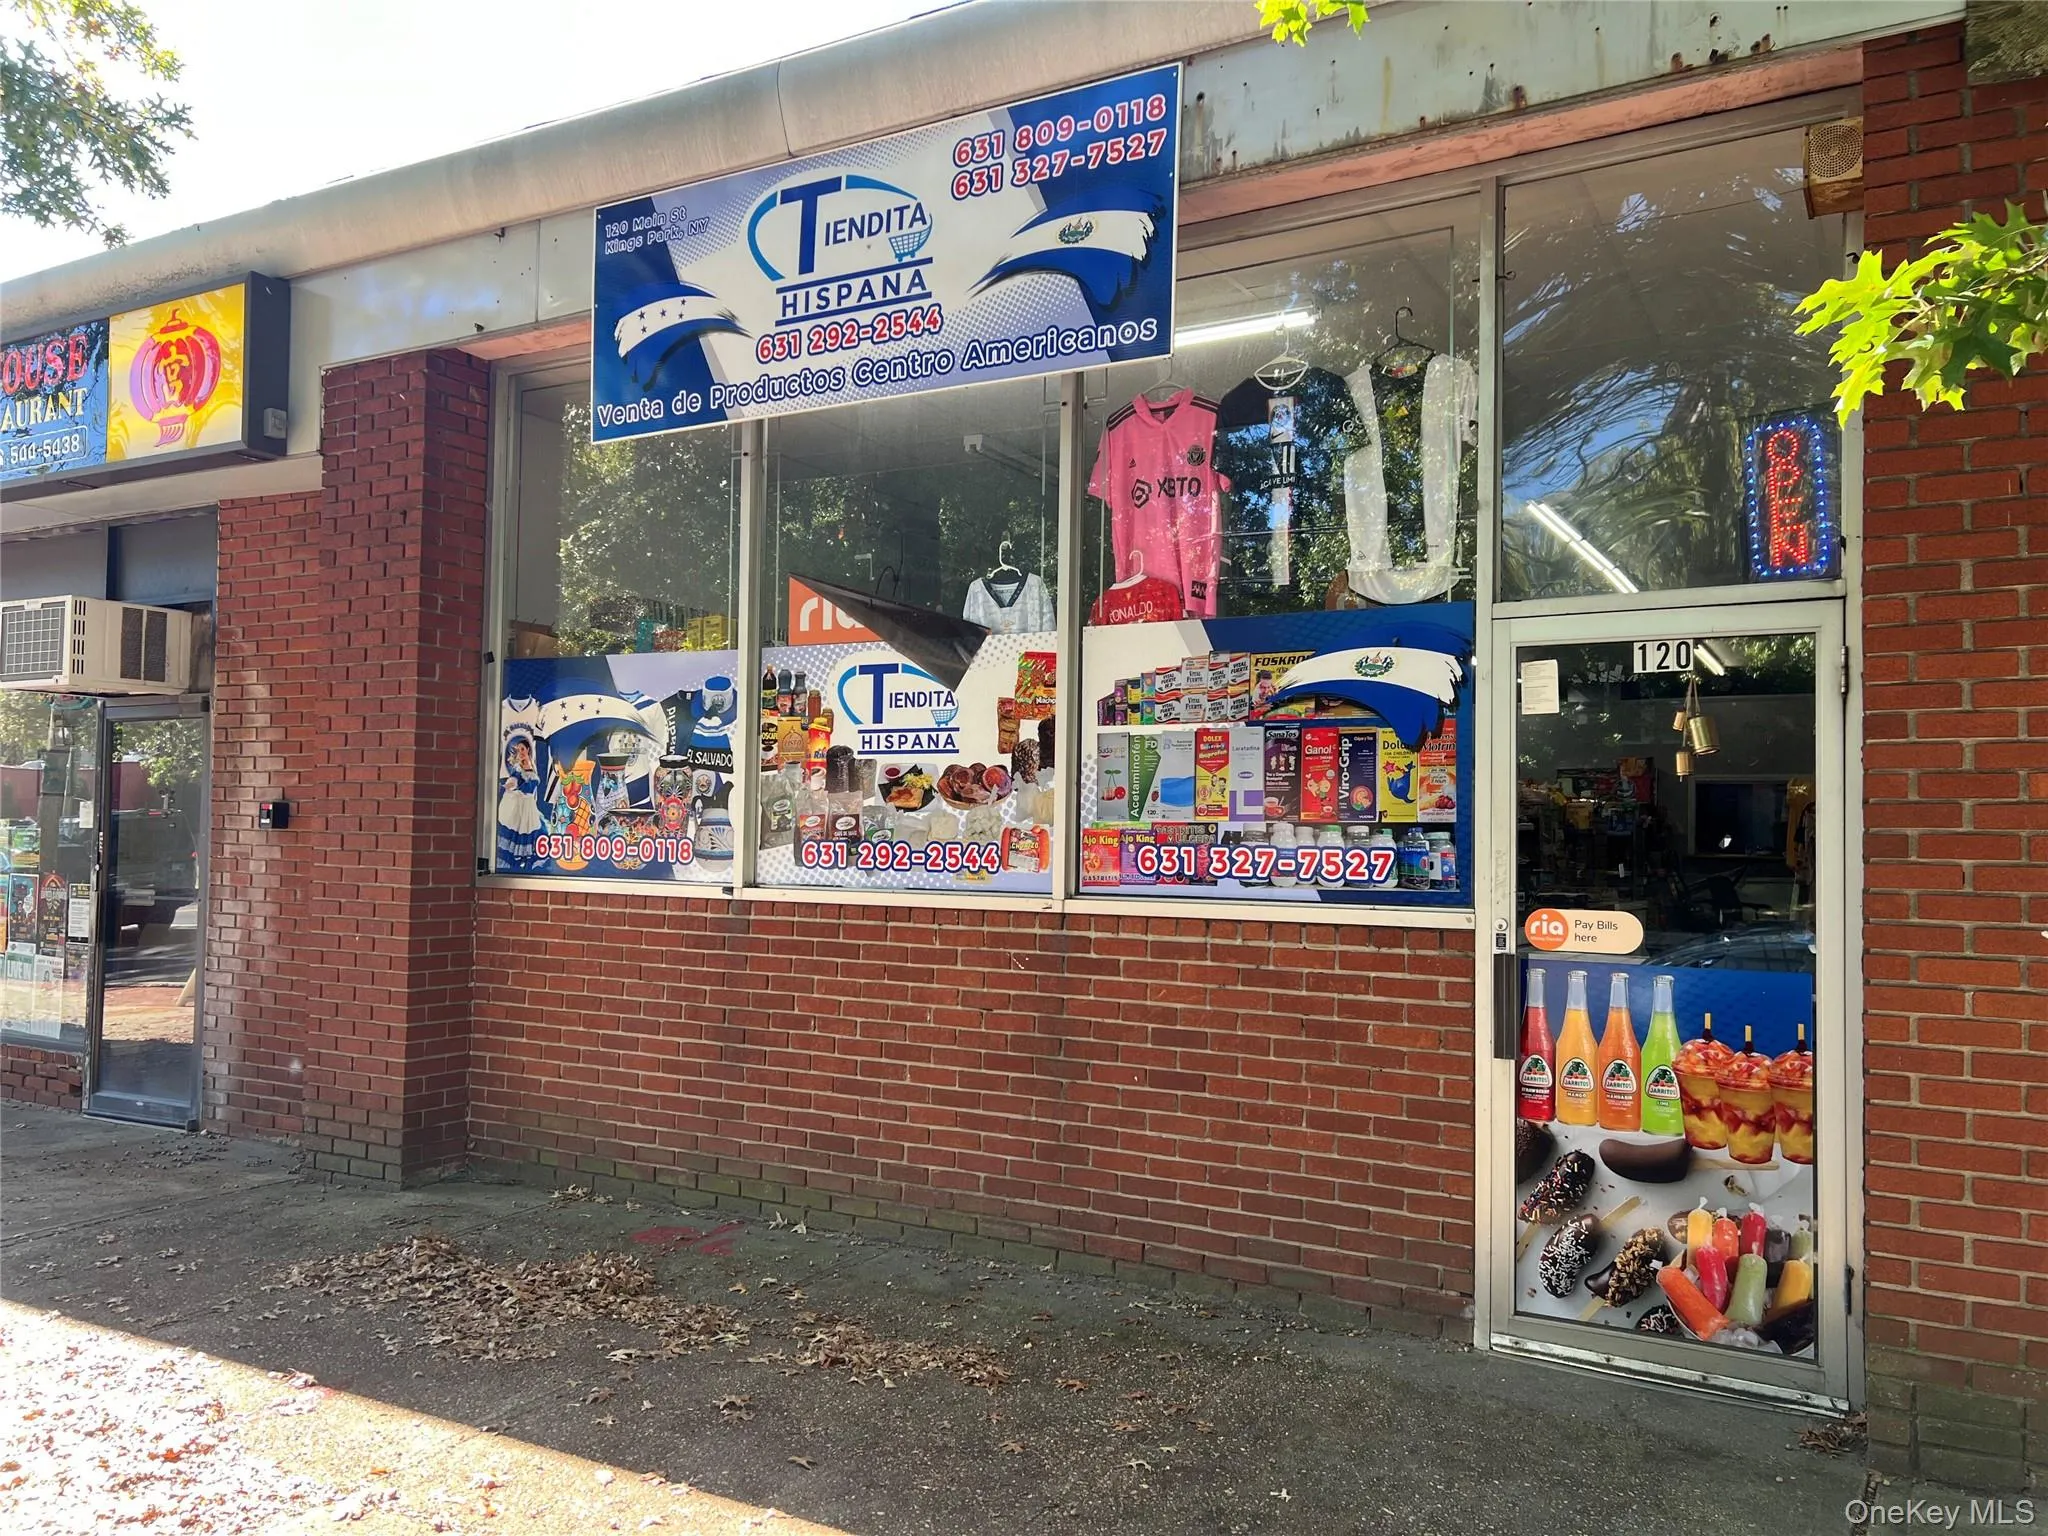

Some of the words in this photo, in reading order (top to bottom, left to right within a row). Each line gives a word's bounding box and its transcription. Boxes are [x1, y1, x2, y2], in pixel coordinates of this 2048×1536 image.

[954, 132, 1004, 168] 631
[1016, 94, 1166, 151] 809-0118
[953, 166, 1001, 199] 631
[1012, 128, 1167, 186] 327-7527
[604, 235, 643, 255] Kings
[647, 225, 683, 243] Park,
[689, 218, 710, 235] NY
[605, 220, 628, 238] 120
[633, 212, 666, 233] Main
[670, 205, 686, 221] St
[780, 175, 927, 275] TIENDITA
[781, 268, 927, 318] HISPANA
[757, 331, 801, 363] 631
[809, 304, 941, 355] 292-2544
[0, 333, 88, 394] OUSE
[598, 398, 664, 427] Venta
[672, 391, 701, 414] de
[710, 367, 844, 410] Productos
[853, 349, 953, 386] Centro
[963, 317, 1158, 370] Americanos
[0, 388, 87, 431] AURANT
[1157, 476, 1202, 498] XBTO
[1766, 430, 1808, 568] OPEN
[1638, 641, 1692, 671] 120
[858, 663, 955, 724] TIENDITA
[861, 732, 956, 750] HISPANA
[1305, 744, 1332, 755] Ganol
[1131, 735, 1141, 817] Acetaminofén
[1339, 736, 1352, 800] Viro-Grip
[536, 835, 574, 859] 631
[581, 835, 693, 865] 809-0118
[802, 841, 848, 868] 631
[858, 841, 1000, 873] 292-2544
[1083, 835, 1097, 847] Ajo
[1100, 836, 1119, 848] King
[1120, 834, 1133, 843] Ajo
[1136, 834, 1155, 844] King
[1137, 845, 1196, 877] 631
[1209, 846, 1396, 883] 327-7527
[1530, 913, 1564, 936] ria
[1574, 920, 1593, 930] Pay
[1597, 920, 1618, 931] Bills
[1574, 933, 1597, 943] here
